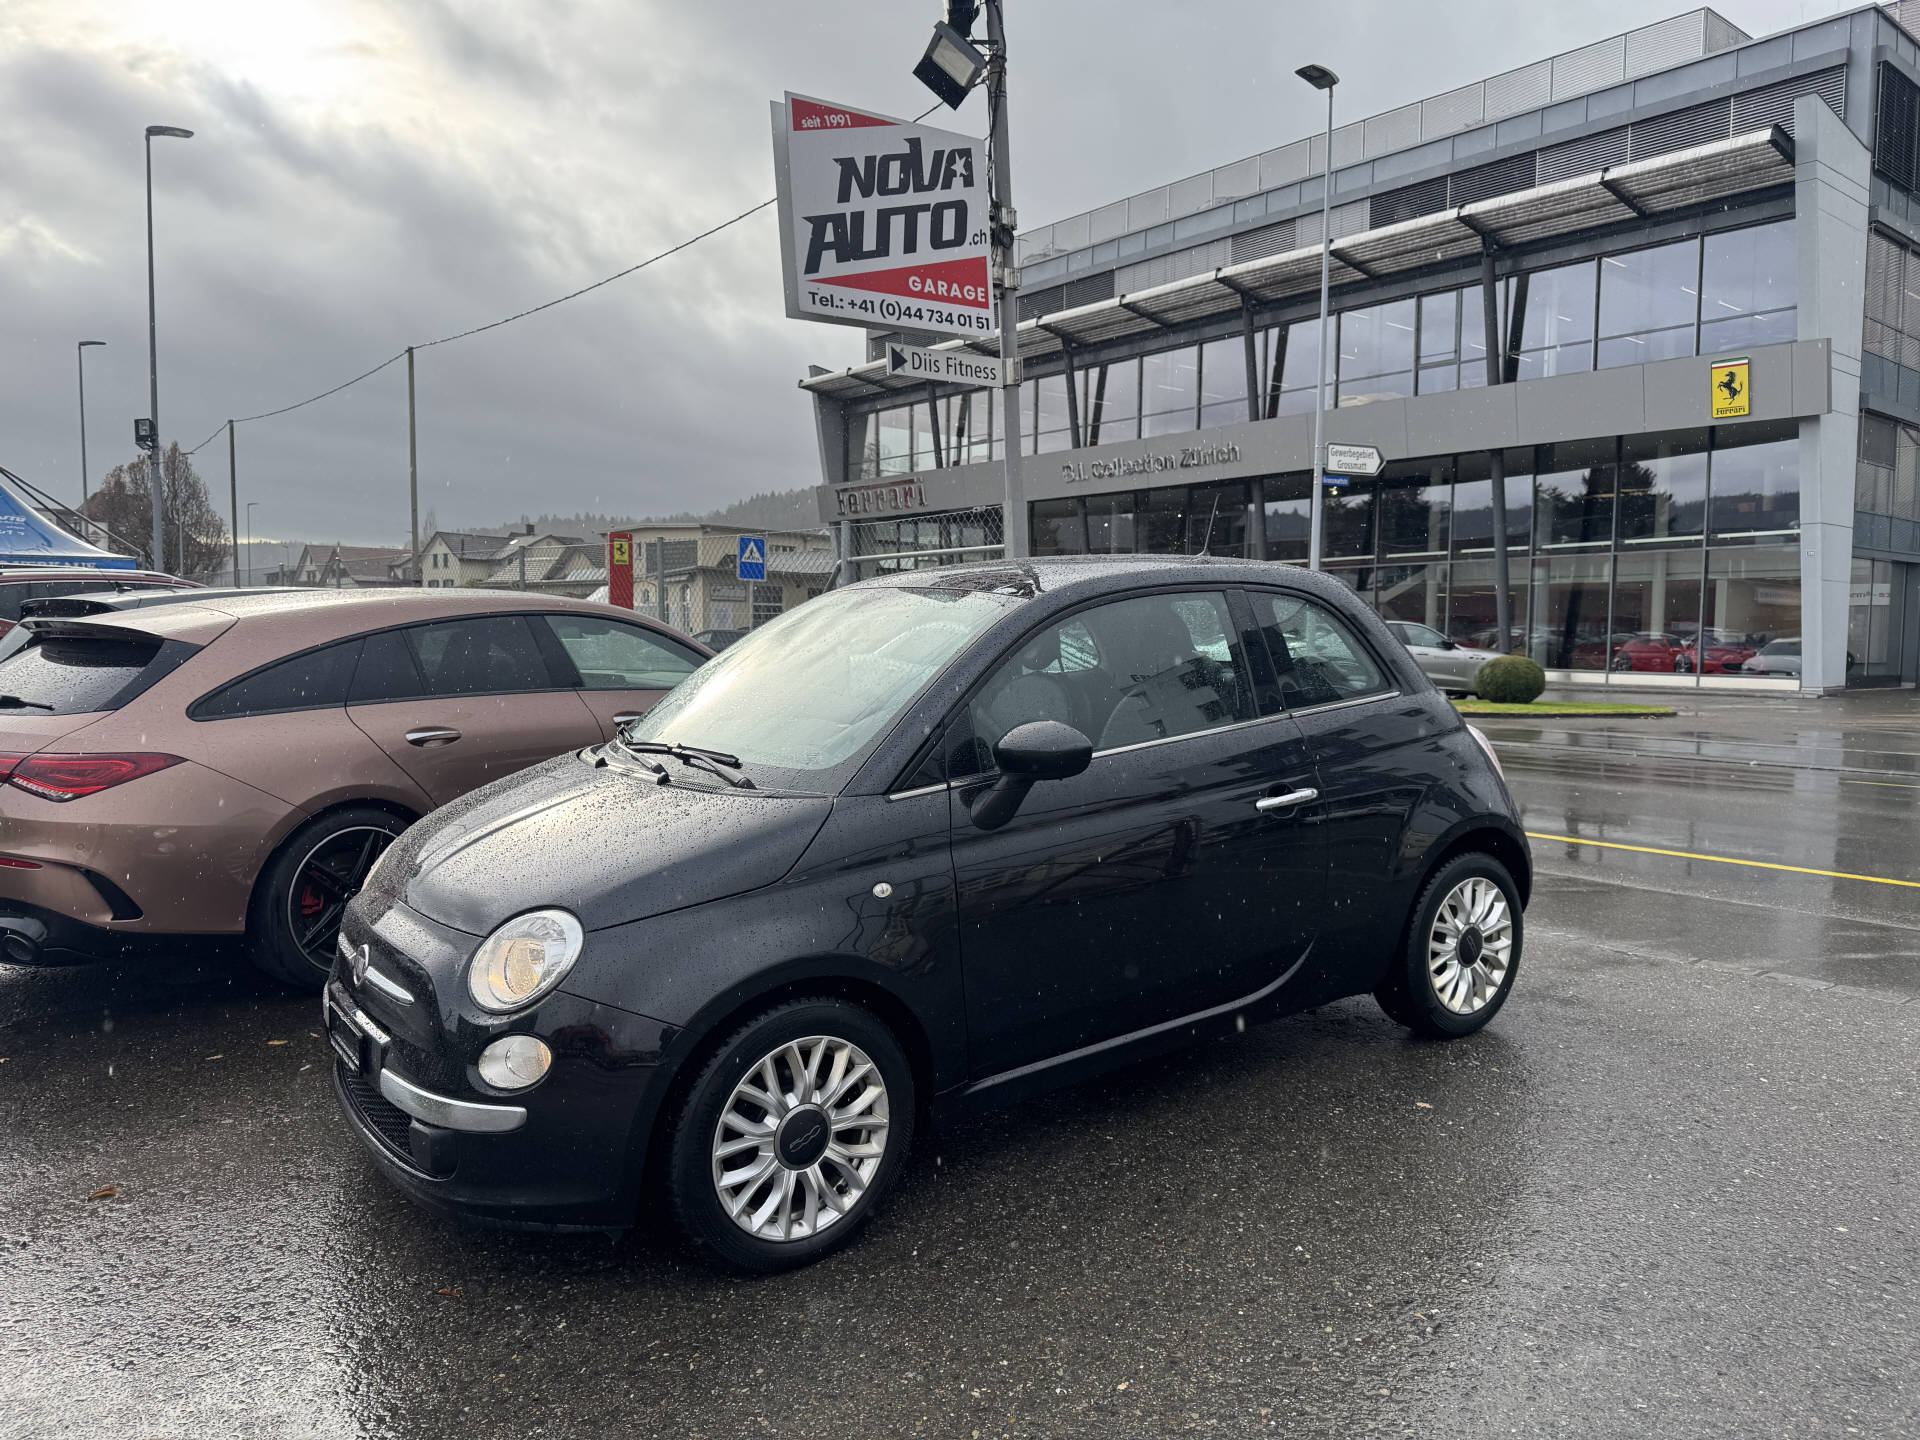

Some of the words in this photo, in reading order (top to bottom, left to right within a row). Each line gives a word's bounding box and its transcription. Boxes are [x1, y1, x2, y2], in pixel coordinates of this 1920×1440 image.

[801, 114, 821, 128] seit
[824, 113, 852, 127] 1991
[832, 136, 975, 204] NOVA
[801, 198, 969, 275] AUTO
[968, 229, 987, 246] .ch
[908, 275, 986, 302] GARAGE
[808, 291, 844, 310] Tel.:
[847, 299, 876, 314] +41
[926, 308, 955, 326] 734
[957, 313, 973, 328] 01
[976, 317, 991, 331] 51
[911, 351, 941, 374] Diis
[945, 358, 998, 381] Fitness
[1092, 452, 1177, 478] Collection
[1180, 442, 1241, 468] Zürich
[1330, 447, 1374, 460] Gewerbegebiet
[1337, 460, 1367, 470] Grossmatt
[835, 476, 928, 515] Ferrari
